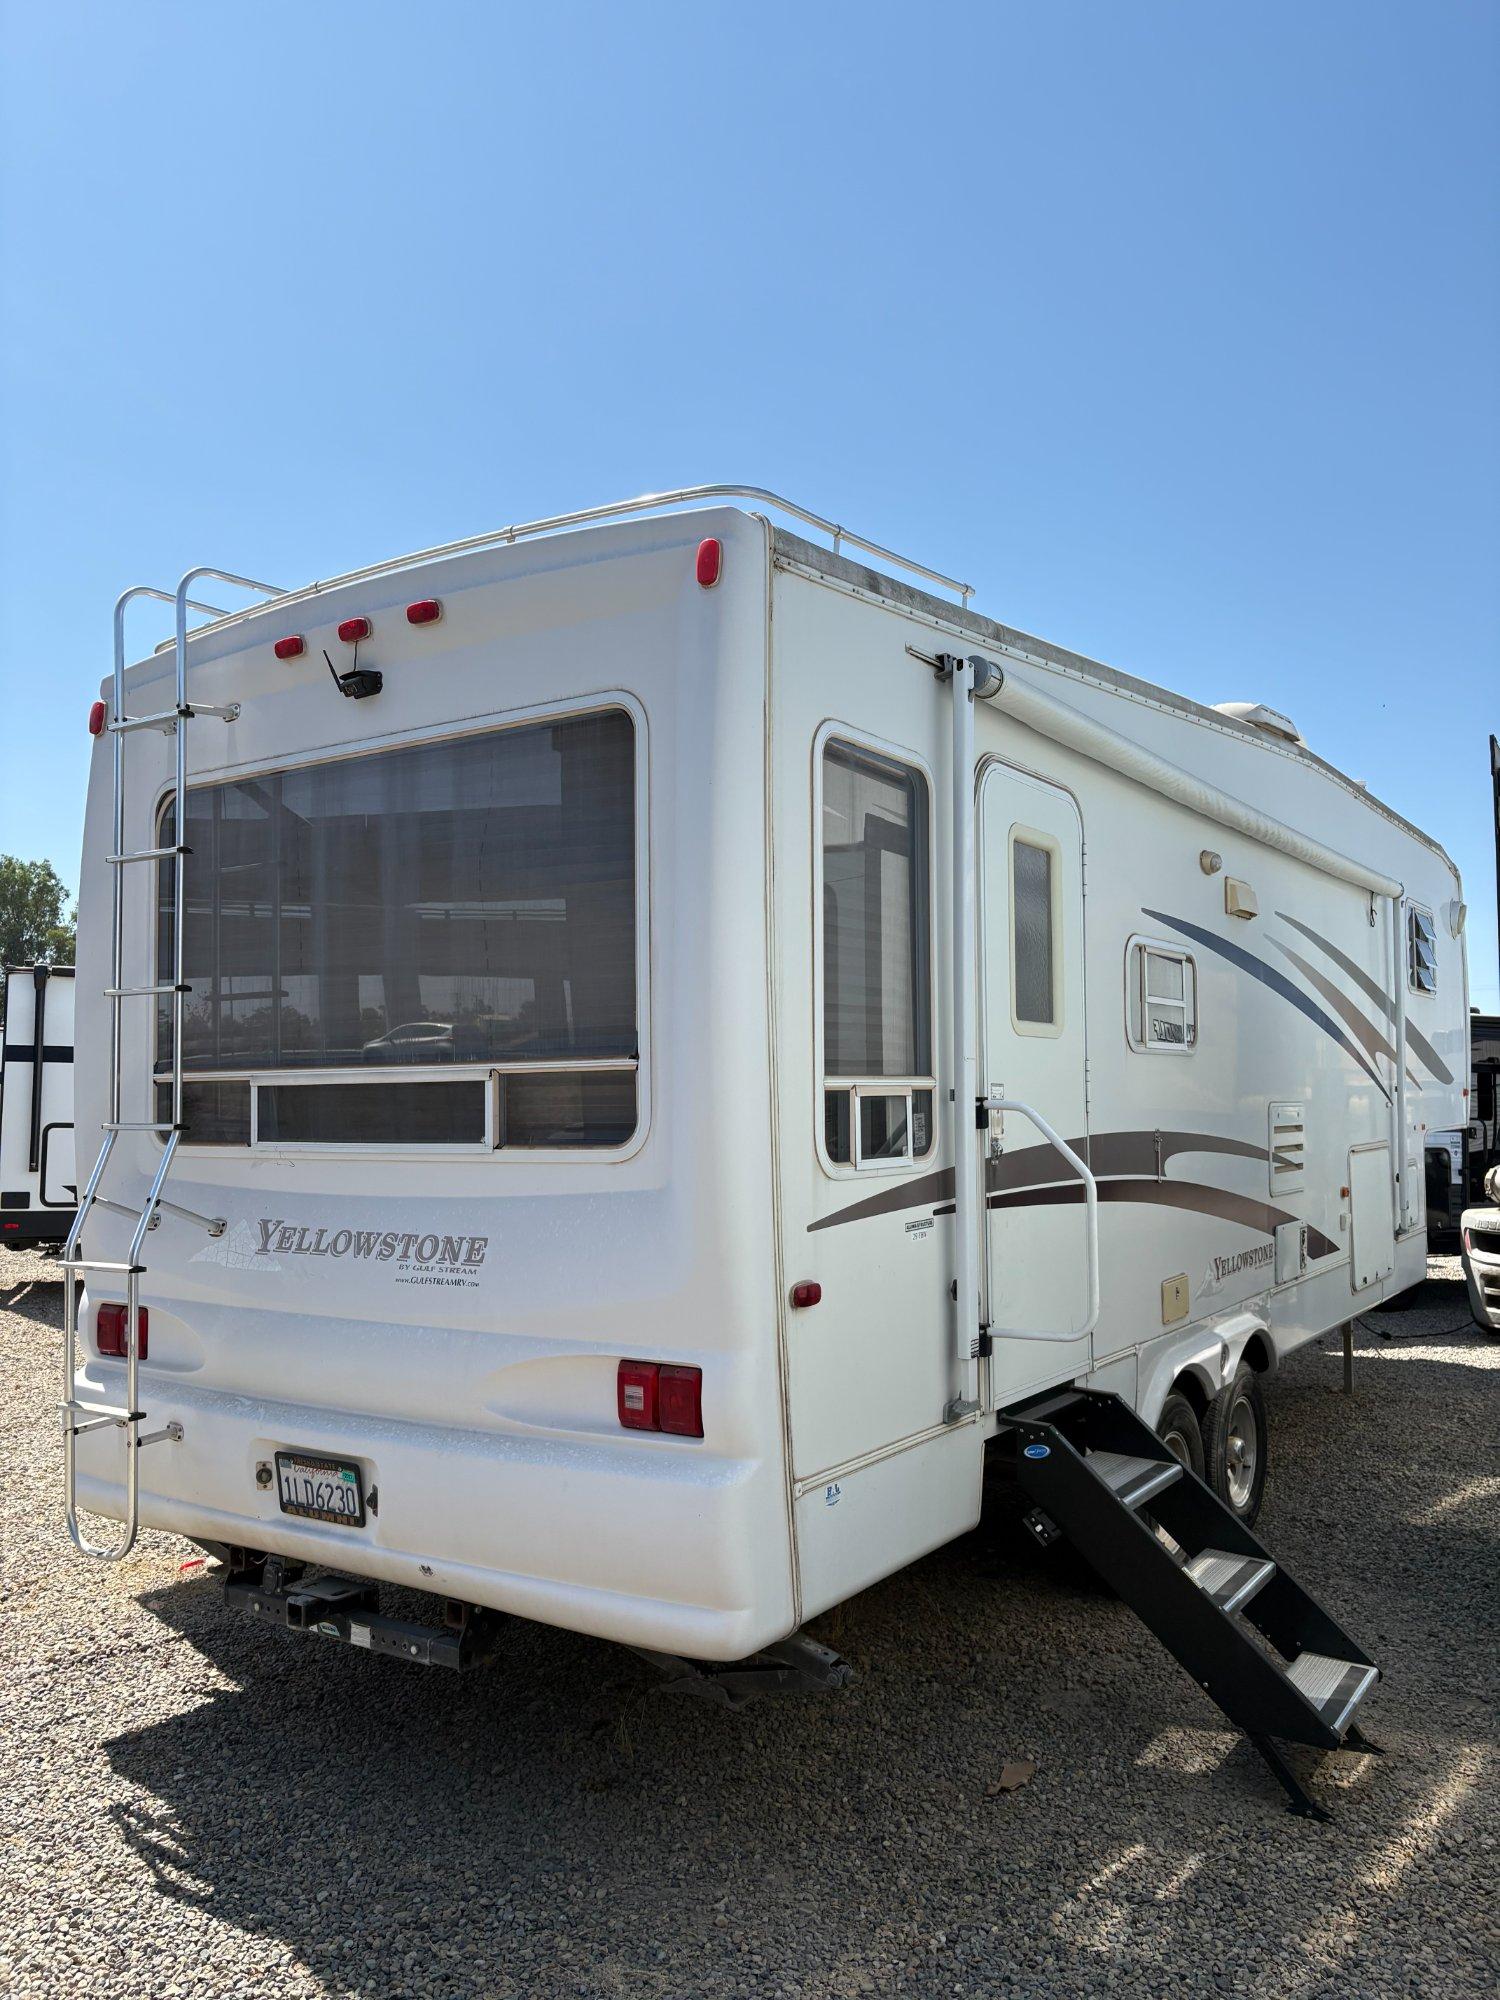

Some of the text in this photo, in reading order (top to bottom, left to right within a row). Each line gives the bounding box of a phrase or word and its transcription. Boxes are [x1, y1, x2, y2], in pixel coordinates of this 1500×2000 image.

[255, 1218, 488, 1267] YELLOWSTONE
[1214, 1243, 1274, 1281] YELLOWSTONE
[438, 1267, 477, 1275] STREAM
[284, 1476, 357, 1516] 1LD6230
